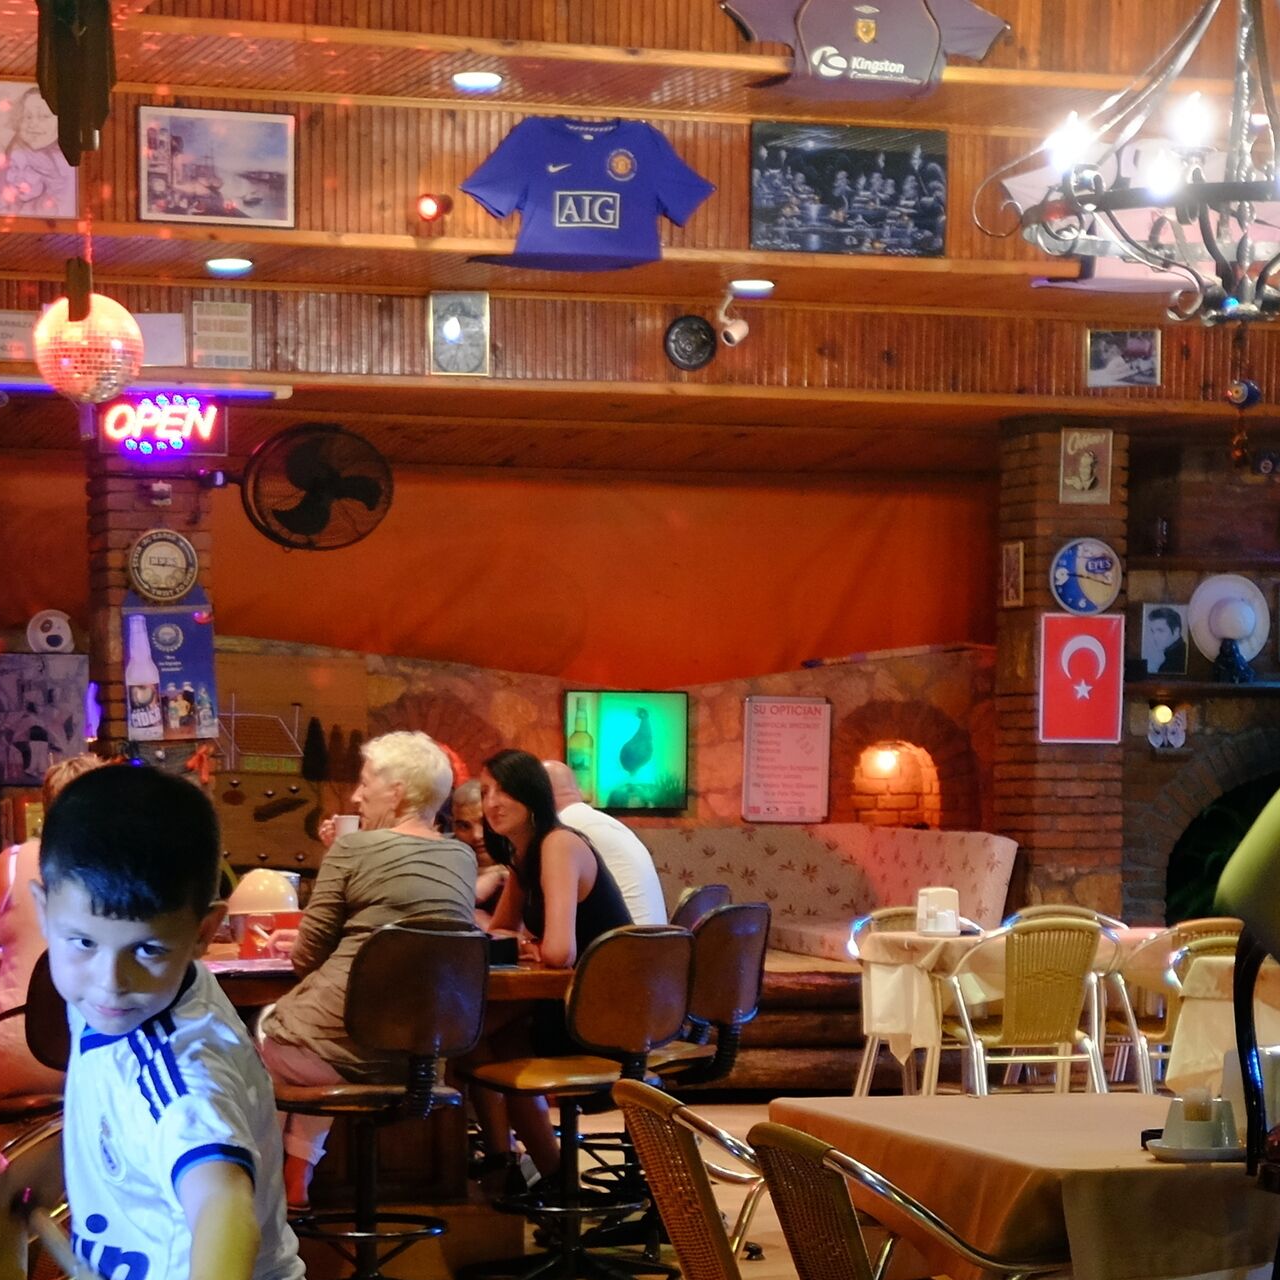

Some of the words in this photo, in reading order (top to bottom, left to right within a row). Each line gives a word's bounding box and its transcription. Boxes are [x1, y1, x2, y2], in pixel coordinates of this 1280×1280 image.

[851, 56, 905, 74] Kingston
[560, 195, 617, 224] AIG
[104, 403, 218, 441] OPEN
[753, 704, 767, 715] SU
[769, 704, 823, 716] OPTICIAN
